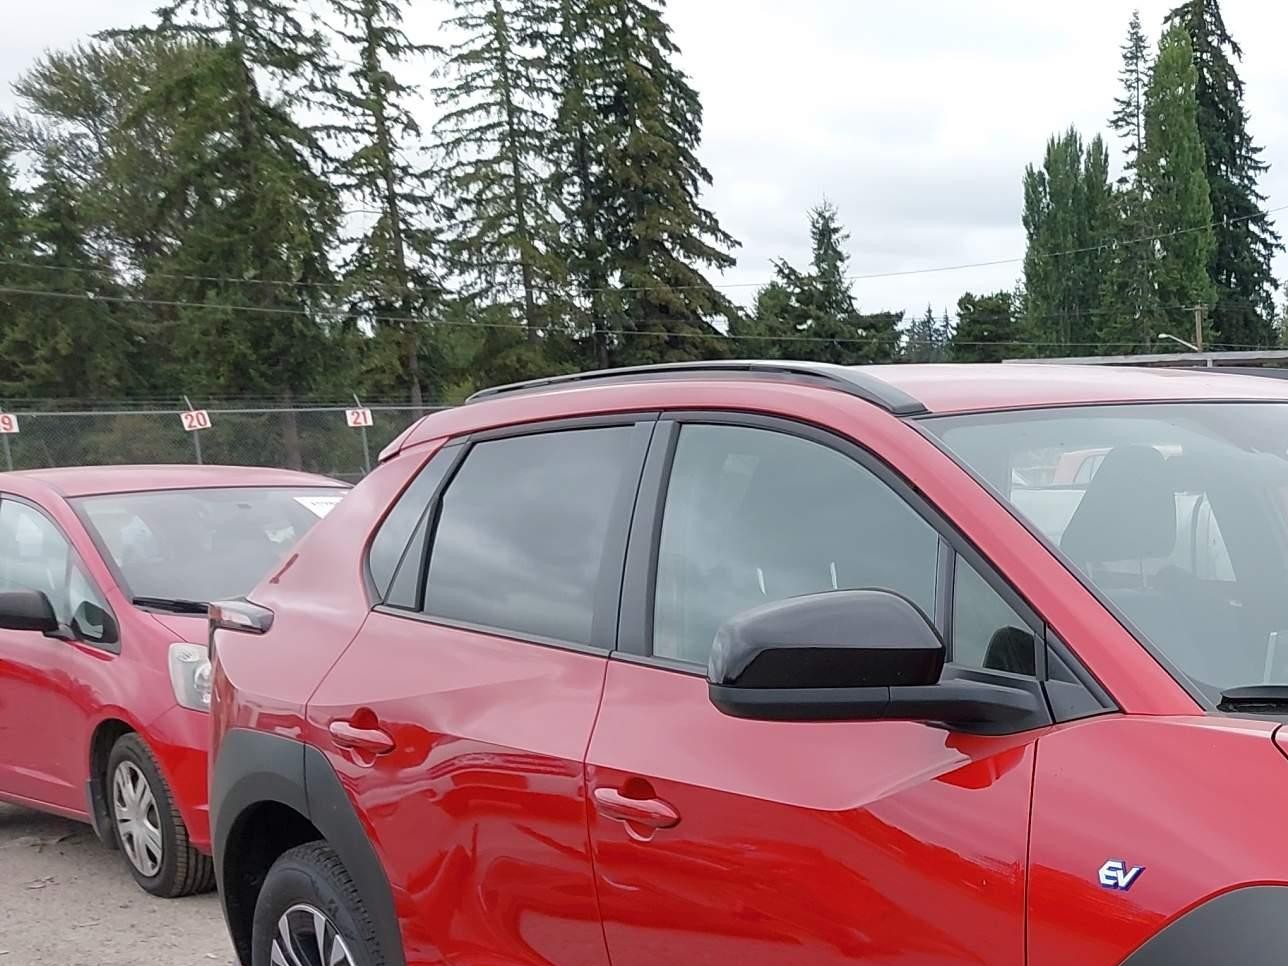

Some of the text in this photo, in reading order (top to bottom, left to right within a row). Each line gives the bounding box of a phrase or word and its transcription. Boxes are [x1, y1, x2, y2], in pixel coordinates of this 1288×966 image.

[184, 411, 208, 428] 20
[351, 410, 368, 425] 21
[1098, 860, 1146, 891] EV
